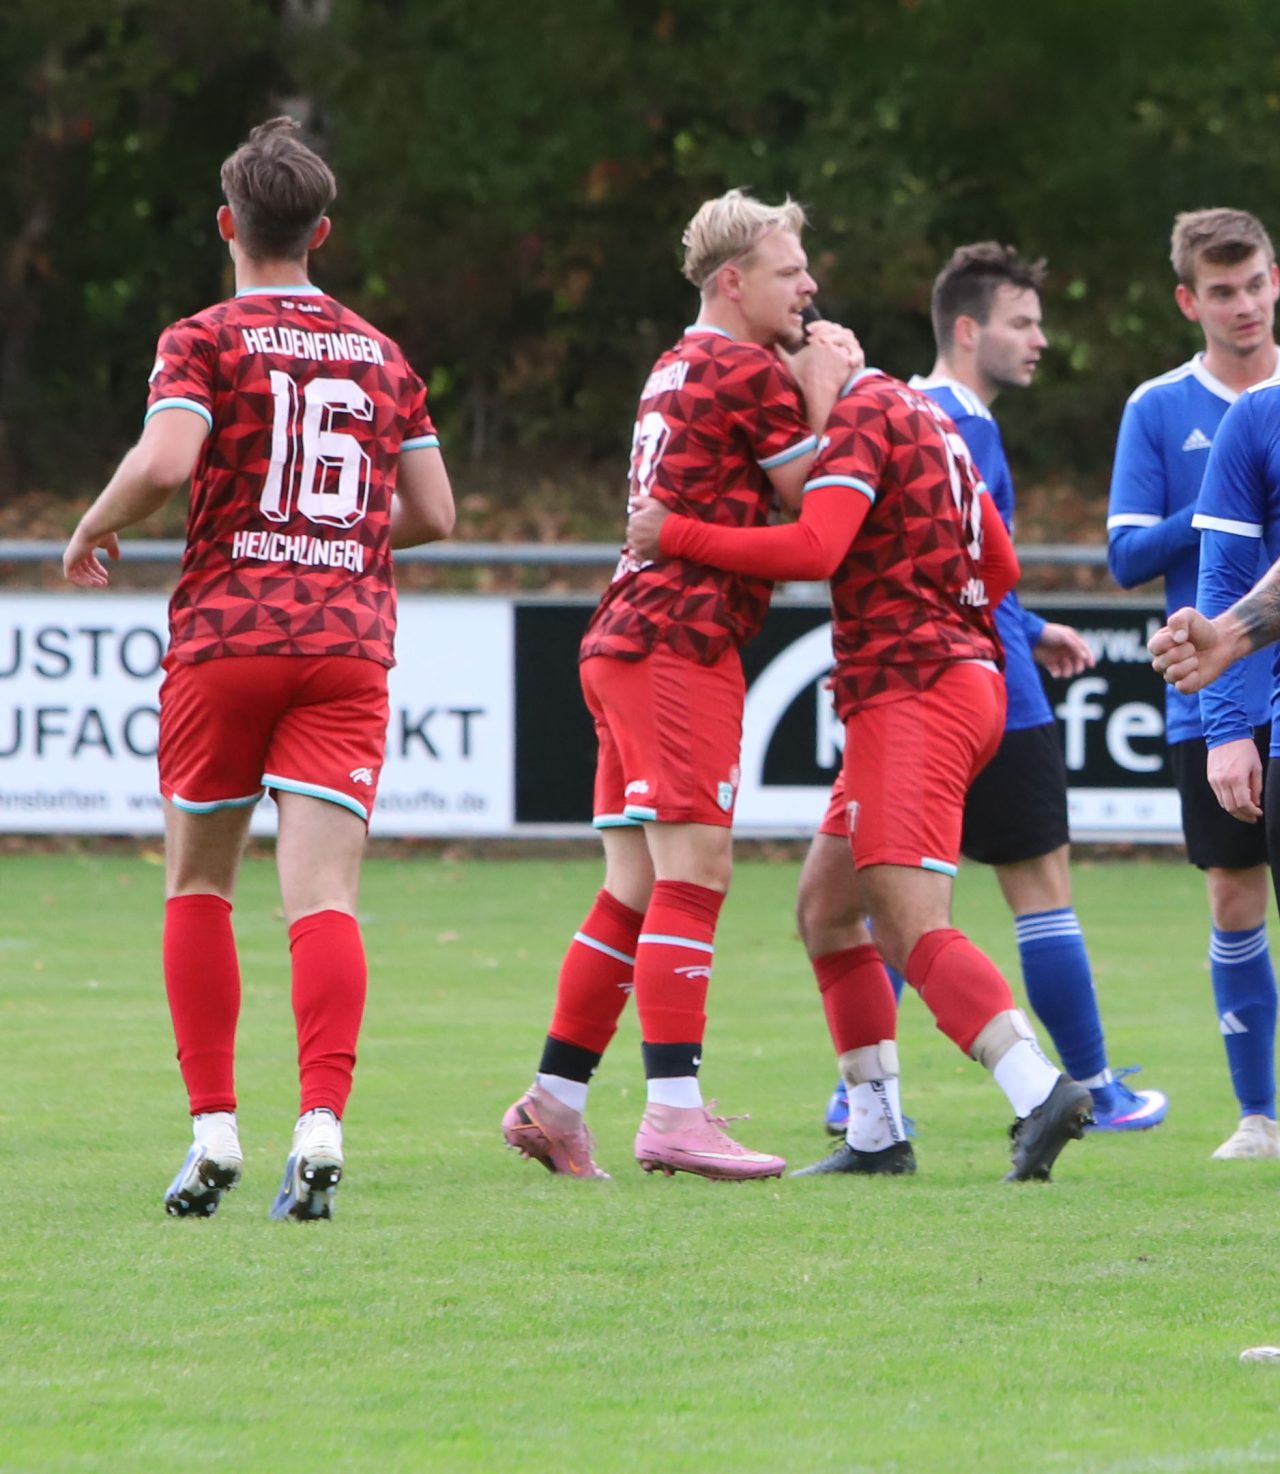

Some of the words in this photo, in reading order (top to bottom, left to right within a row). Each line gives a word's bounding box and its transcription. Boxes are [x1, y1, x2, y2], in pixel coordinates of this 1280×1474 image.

[241, 328, 385, 367] HELDENFINGEN
[258, 369, 374, 529] 16
[231, 530, 364, 574] HEUCHLINGEN
